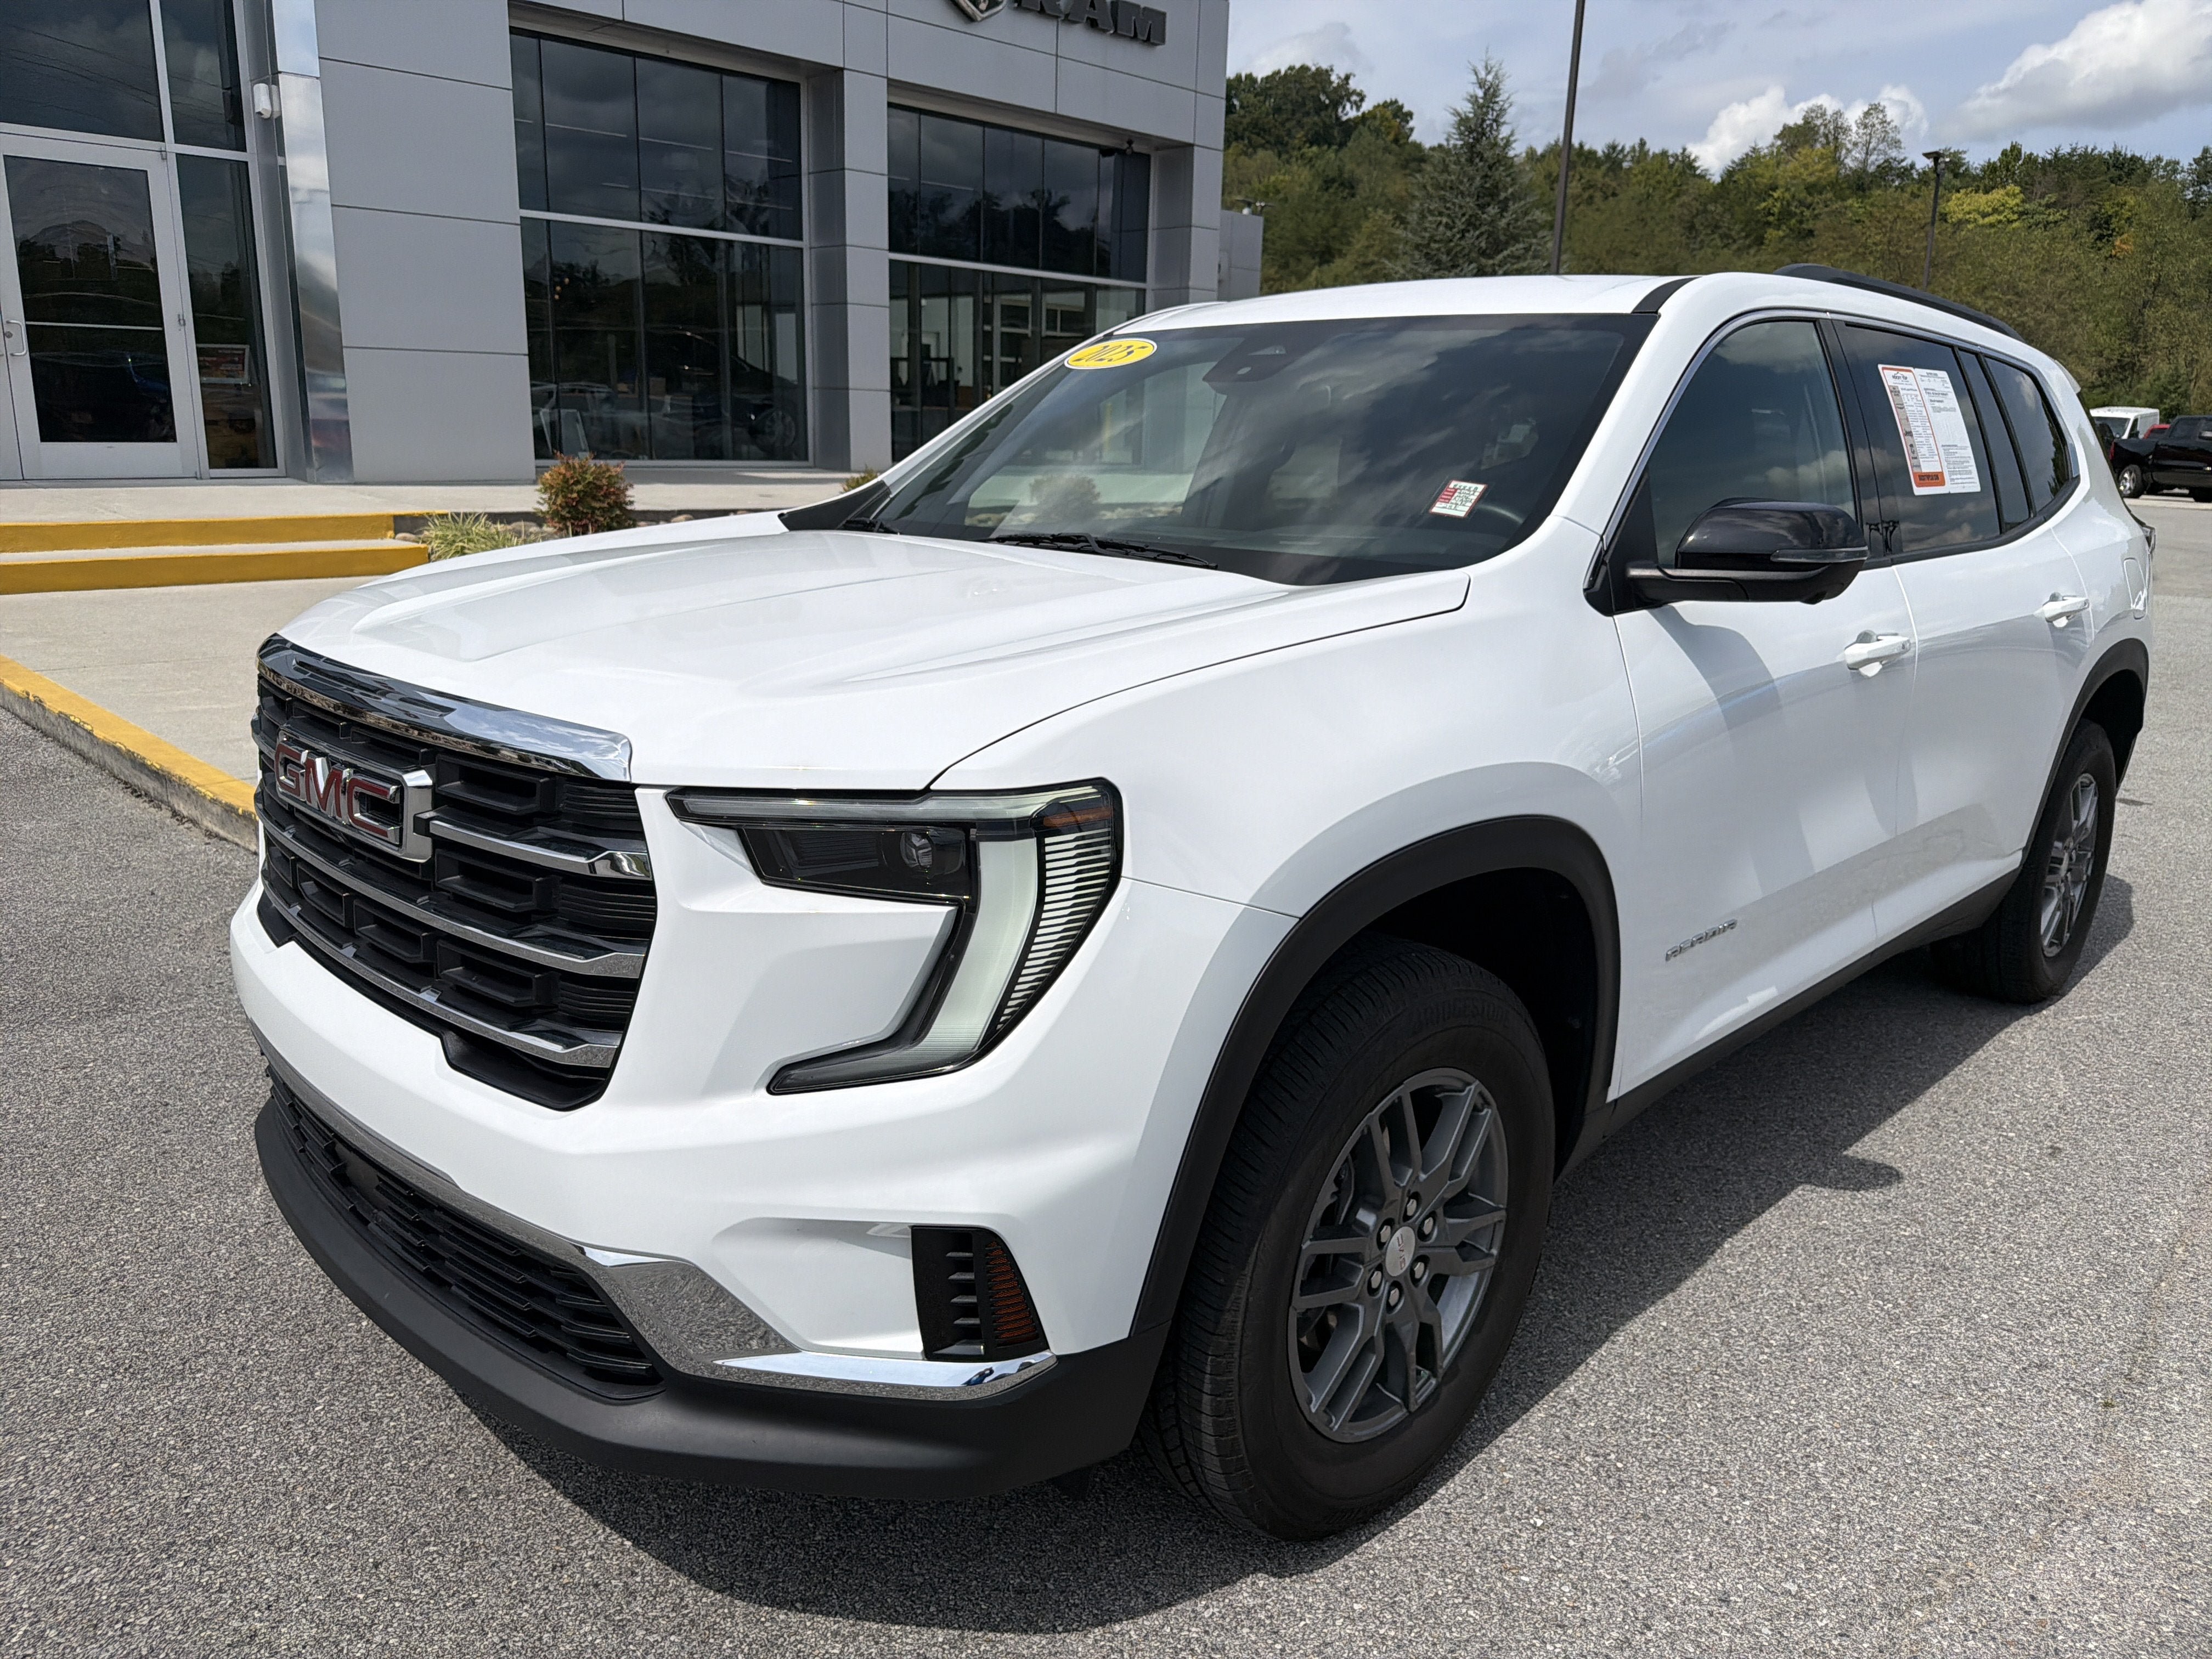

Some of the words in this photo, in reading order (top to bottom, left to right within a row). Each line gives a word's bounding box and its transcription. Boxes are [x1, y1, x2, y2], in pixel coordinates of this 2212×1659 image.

[1071, 344, 1149, 362] 2025
[274, 740, 400, 846] GMC
[1665, 918, 1738, 962] ACADIA
[1396, 1233, 1406, 1271] GMC
